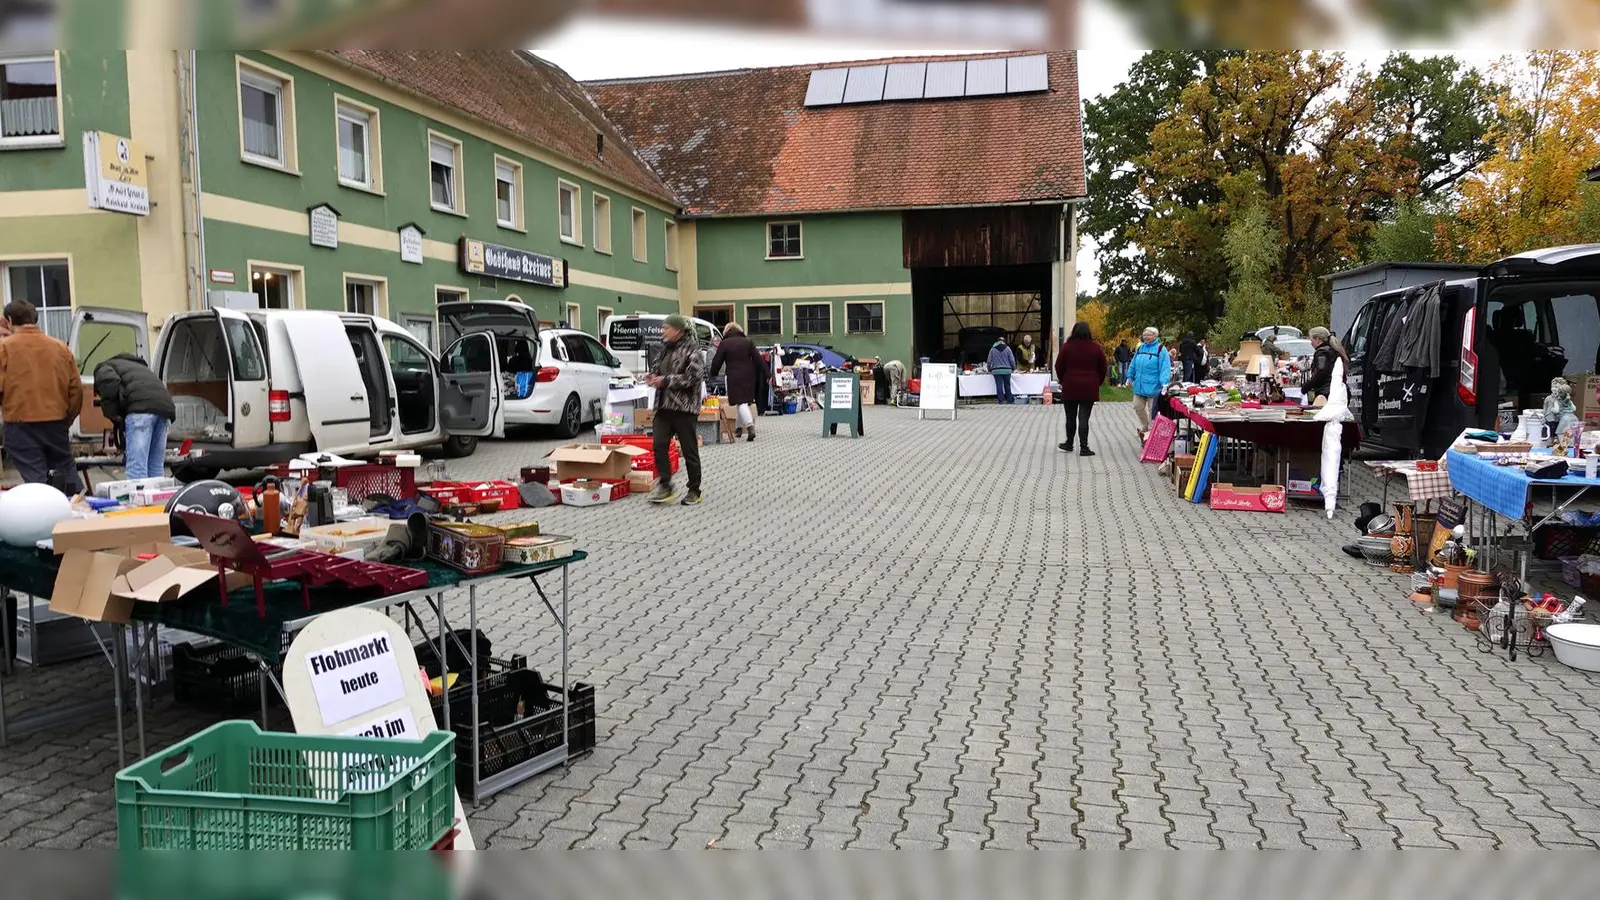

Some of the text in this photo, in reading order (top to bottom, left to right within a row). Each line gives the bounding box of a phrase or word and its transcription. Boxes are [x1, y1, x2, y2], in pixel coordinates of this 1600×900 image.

[485, 248, 520, 274] Gasthaus
[310, 636, 390, 675] Flohmarkt
[340, 671, 379, 695] heute
[384, 718, 406, 738] im
